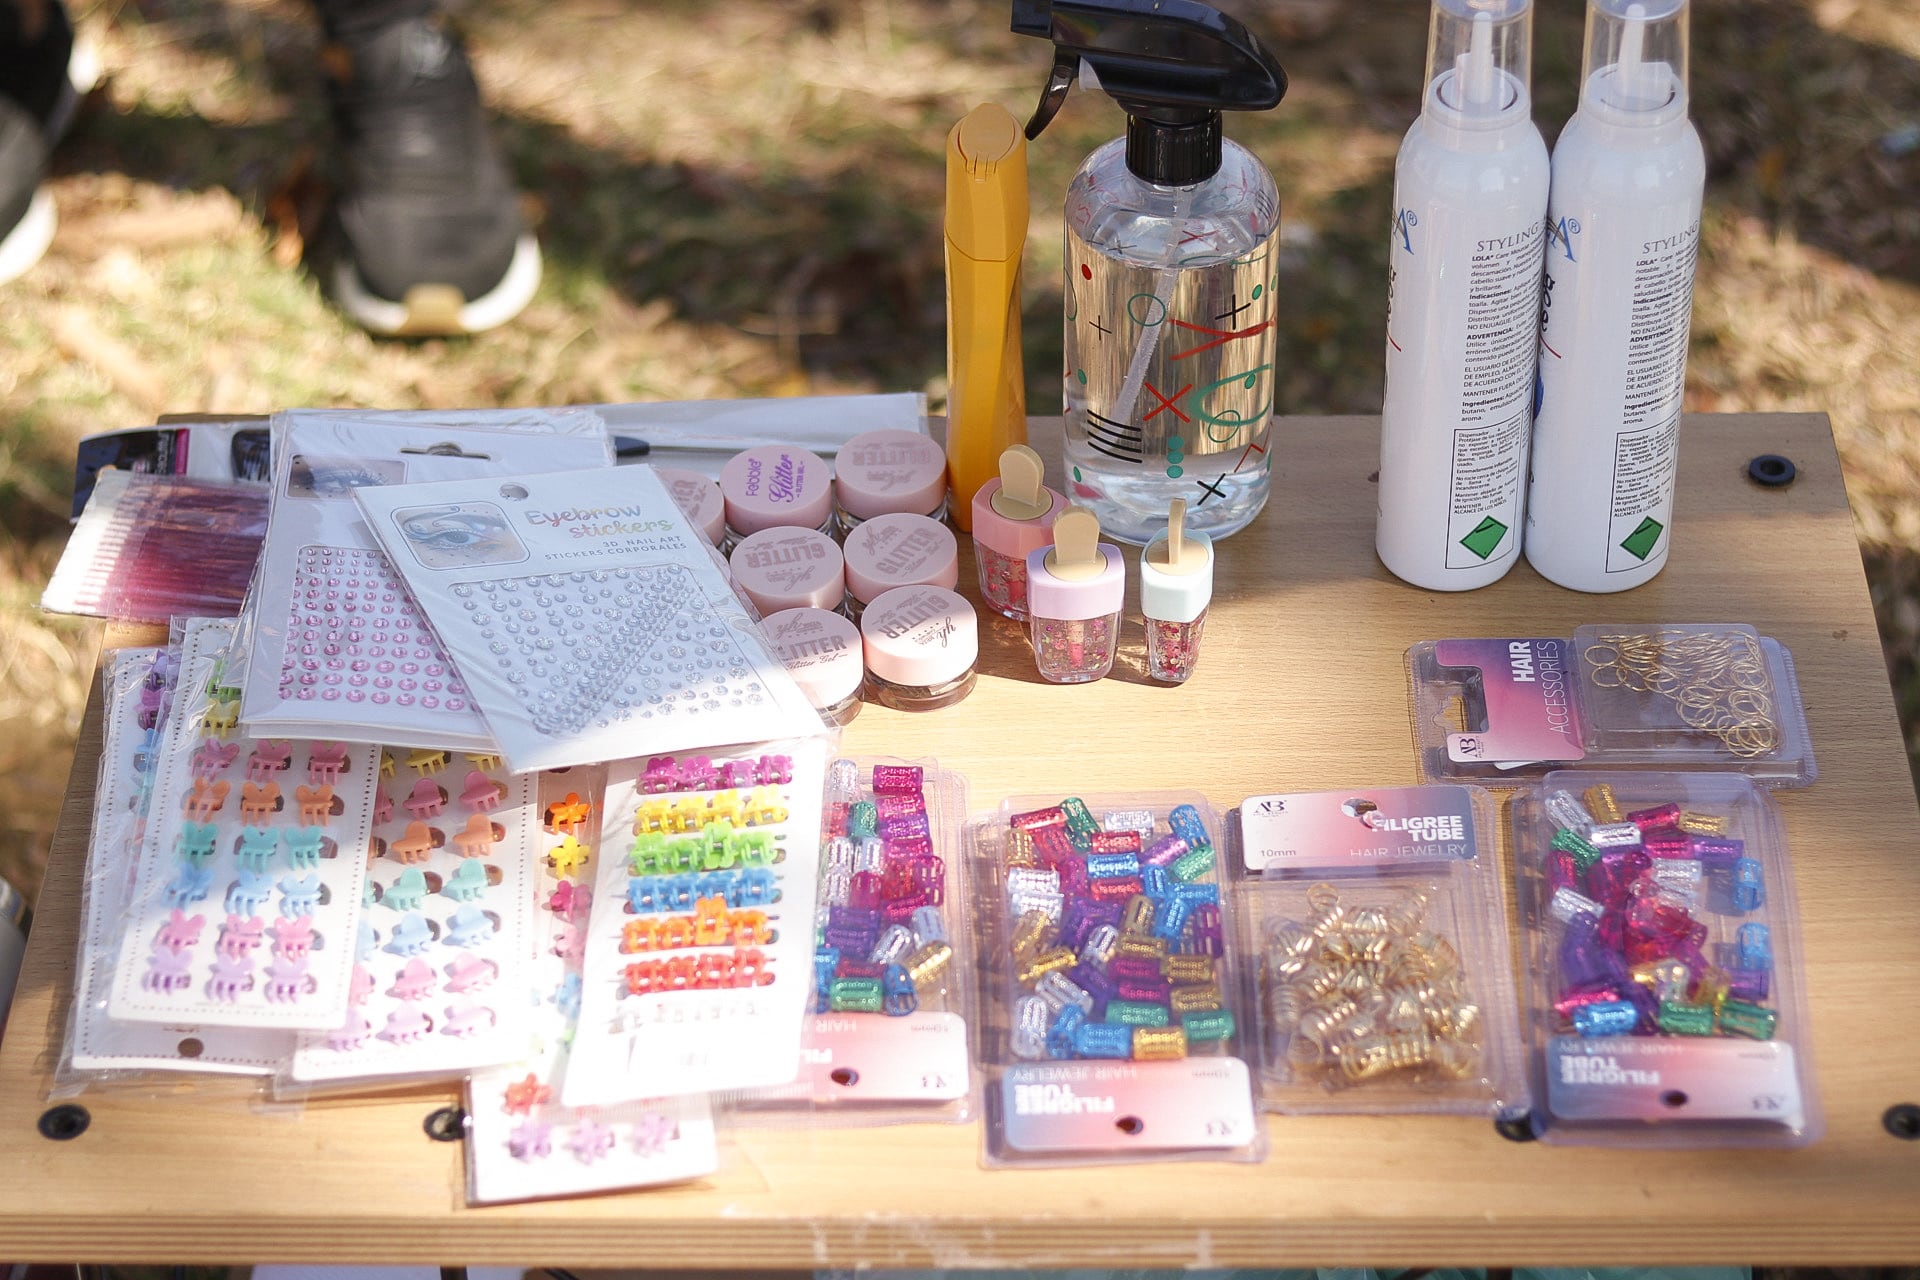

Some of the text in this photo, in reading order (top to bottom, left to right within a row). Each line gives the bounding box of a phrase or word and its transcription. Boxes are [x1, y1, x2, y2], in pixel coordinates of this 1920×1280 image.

[1477, 221, 1540, 252] STYLING
[1470, 277, 1494, 285] cabello
[1469, 289, 1512, 300] Indicaciones:
[1467, 314, 1500, 323] Distribuya
[1468, 308, 1498, 316] Dispense
[1466, 326, 1514, 340] ADVERTENCIA:
[1465, 348, 1491, 356] erróneo
[1465, 354, 1498, 363] contenido
[1473, 361, 1501, 373] USUARIO
[1635, 364, 1662, 375] USUARIO
[1473, 375, 1504, 387] ACUERDO
[1635, 376, 1664, 389] ACUERDO
[1462, 387, 1498, 398] MANTENER
[1498, 380, 1516, 392] FUERA
[1624, 389, 1659, 400] MANTENER
[1462, 396, 1505, 408] Ingredientes:
[852, 448, 932, 466] GLITTER
[768, 453, 794, 503] Glitter
[523, 504, 642, 528] Eyebrow
[569, 519, 676, 540] stickers
[626, 538, 656, 546] NAIL
[660, 535, 683, 543] ART
[544, 542, 688, 561] STICKERS CORPORALES
[744, 542, 826, 569] GLITTER
[875, 527, 938, 575] GLITTER
[877, 594, 950, 640] GLITTER
[1508, 640, 1536, 682] HAIR
[1536, 640, 1572, 735] ACCESSORIES
[1407, 827, 1465, 842] TUBE
[1260, 848, 1297, 858] 10mm
[1350, 847, 1389, 858] HAIR
[816, 1019, 857, 1033] HAIR
[1560, 1055, 1617, 1070] TUBE
[1012, 1066, 1137, 1082] HAIR JEWELRY
[1561, 1069, 1660, 1085] FILIGREE
[1014, 1083, 1072, 1099] TUBE
[1015, 1096, 1115, 1115] FILIGREE
